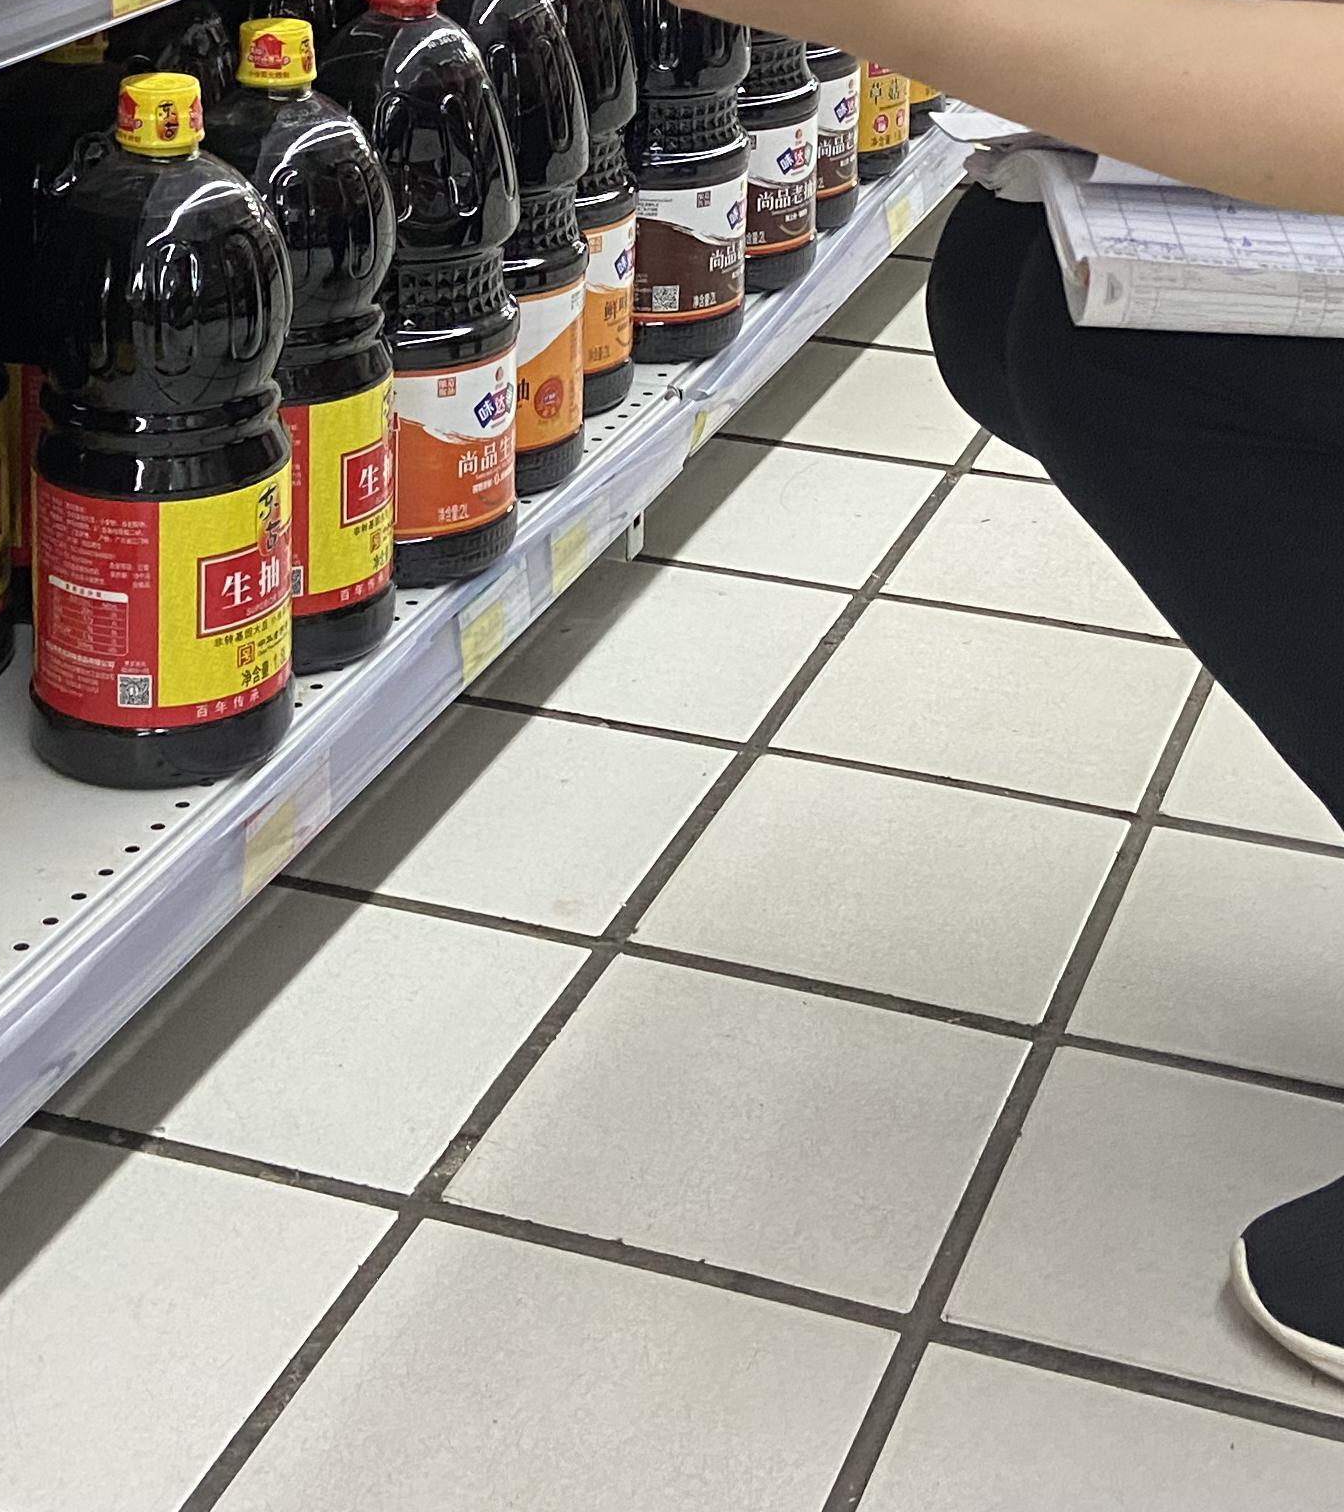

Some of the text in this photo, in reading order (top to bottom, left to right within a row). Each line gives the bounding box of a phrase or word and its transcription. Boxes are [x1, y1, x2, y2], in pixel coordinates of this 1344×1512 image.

[220, 556, 280, 611] 生抽
[195, 690, 262, 719] 百年传承
